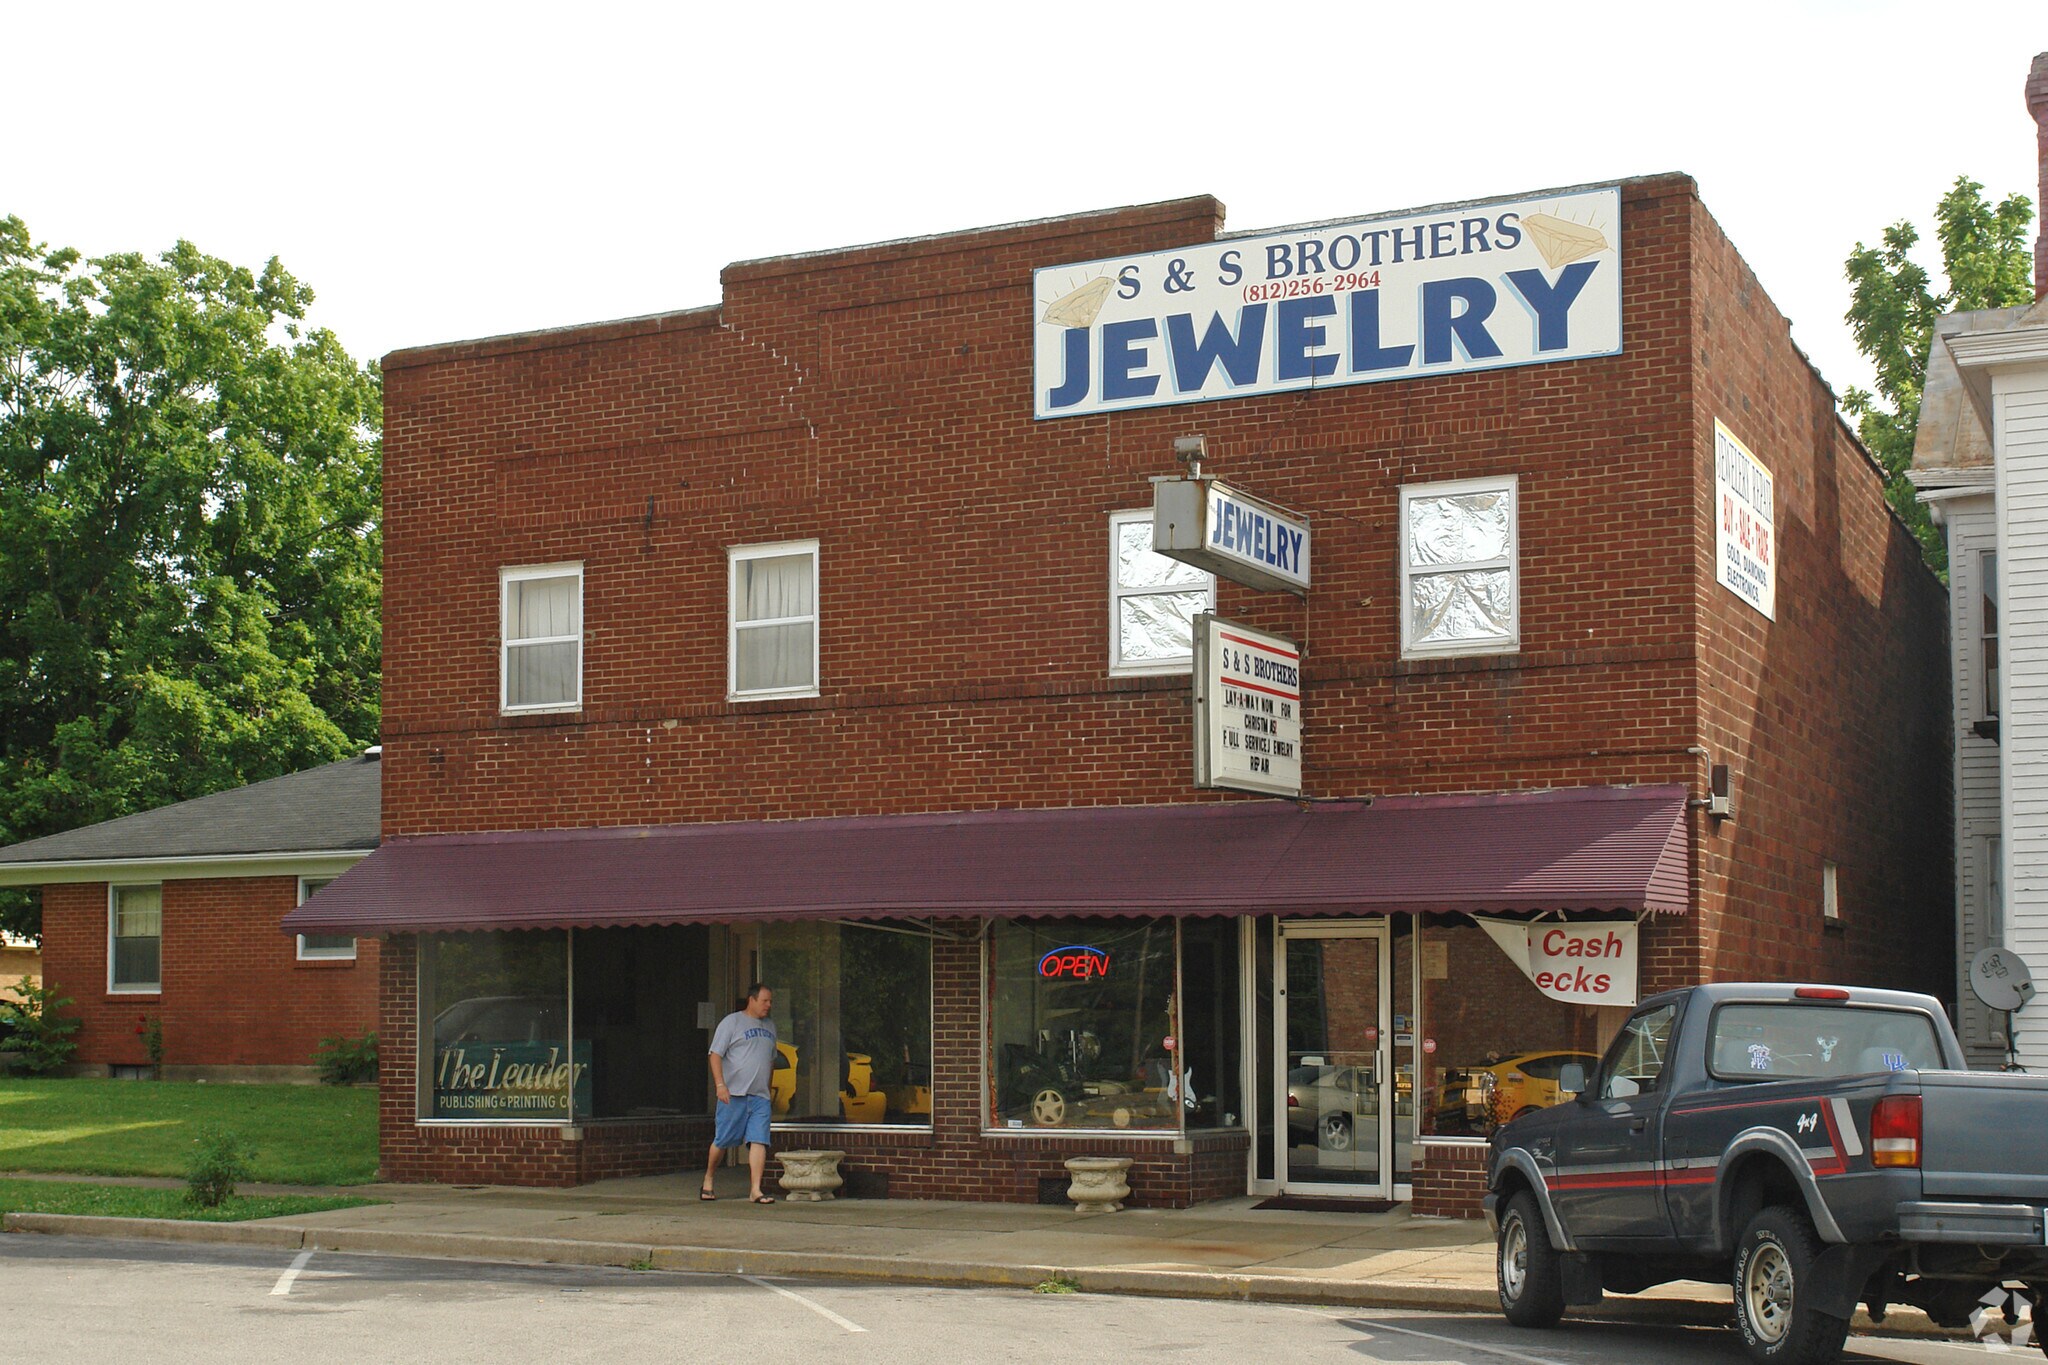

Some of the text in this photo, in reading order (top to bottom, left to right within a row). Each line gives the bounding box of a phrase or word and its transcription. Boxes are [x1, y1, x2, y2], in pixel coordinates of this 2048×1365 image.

[1117, 211, 1523, 301] S & S BROTHERS
[1242, 271, 1382, 304] (812)256-2964
[1046, 259, 1600, 410] JEWELRY
[1212, 497, 1303, 575] JEWELRY
[1223, 647, 1298, 688] S & S BROTHERS
[1281, 702, 1291, 719] FOR
[1542, 929, 1624, 959] Cash
[1041, 955, 1111, 977] OPEN
[1533, 965, 1611, 994] ecks
[434, 1046, 588, 1091] The Leader
[440, 1095, 498, 1109] PUBLISHING
[507, 1095, 556, 1109] PRINTING
[1797, 1112, 1818, 1134] 4x4
